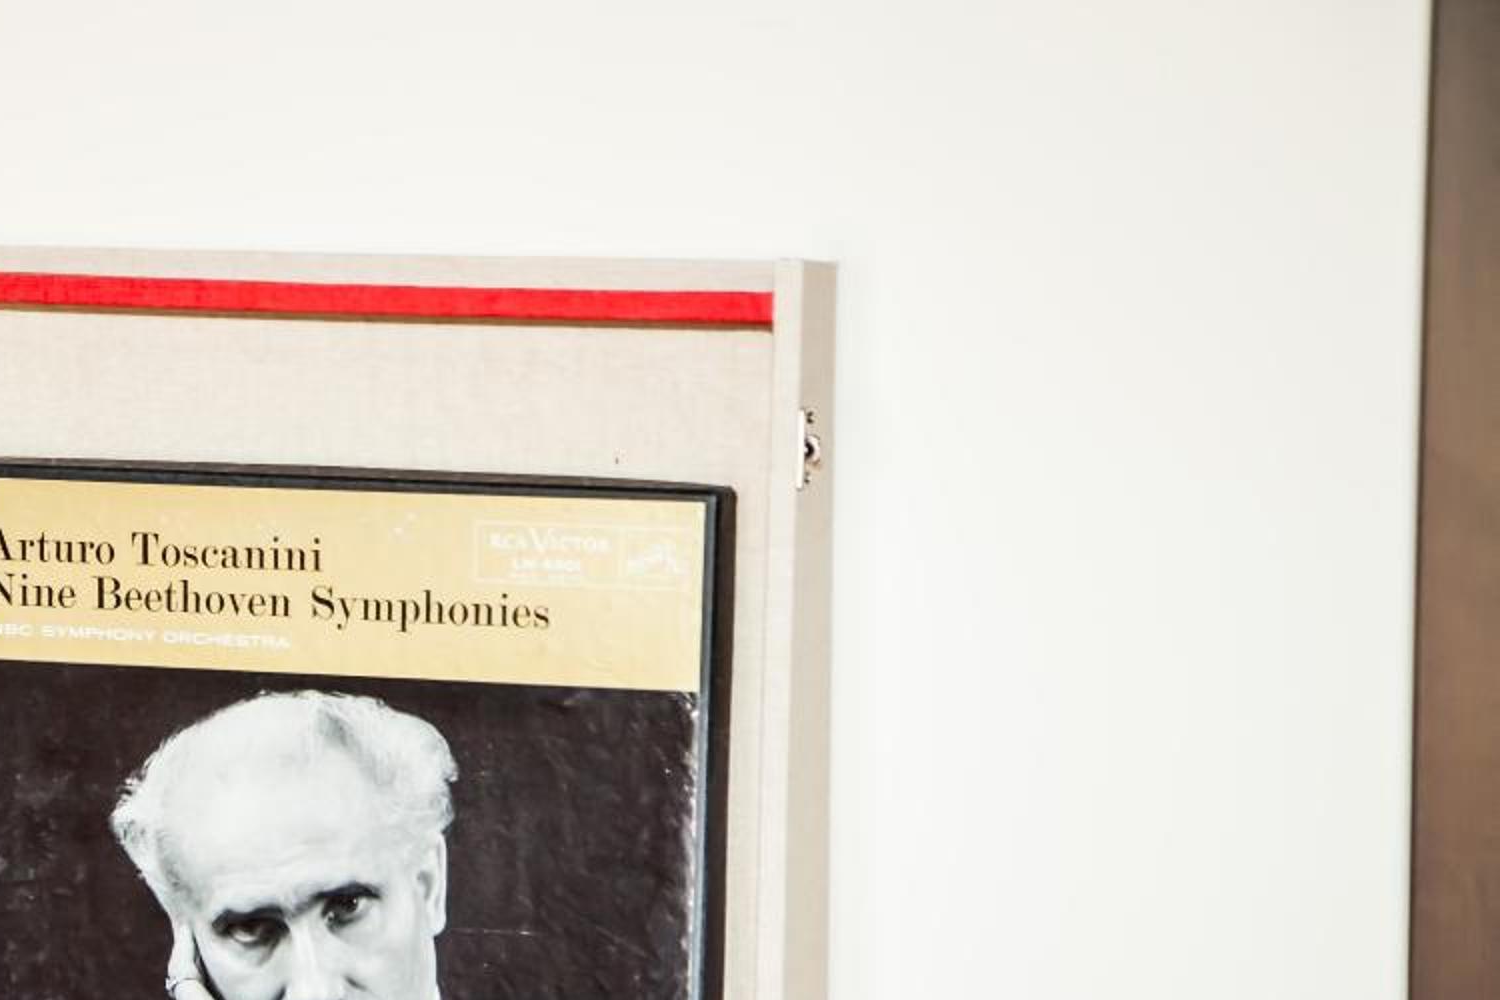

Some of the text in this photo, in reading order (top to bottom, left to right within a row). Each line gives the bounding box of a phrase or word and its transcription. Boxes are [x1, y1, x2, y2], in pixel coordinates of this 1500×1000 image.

[131, 531, 322, 572] Toscanini
[95, 576, 291, 618] Beethoven
[310, 586, 550, 633] Symphonies
[42, 624, 156, 644] SYMPHONY
[162, 631, 291, 650] ORCHESTRA
